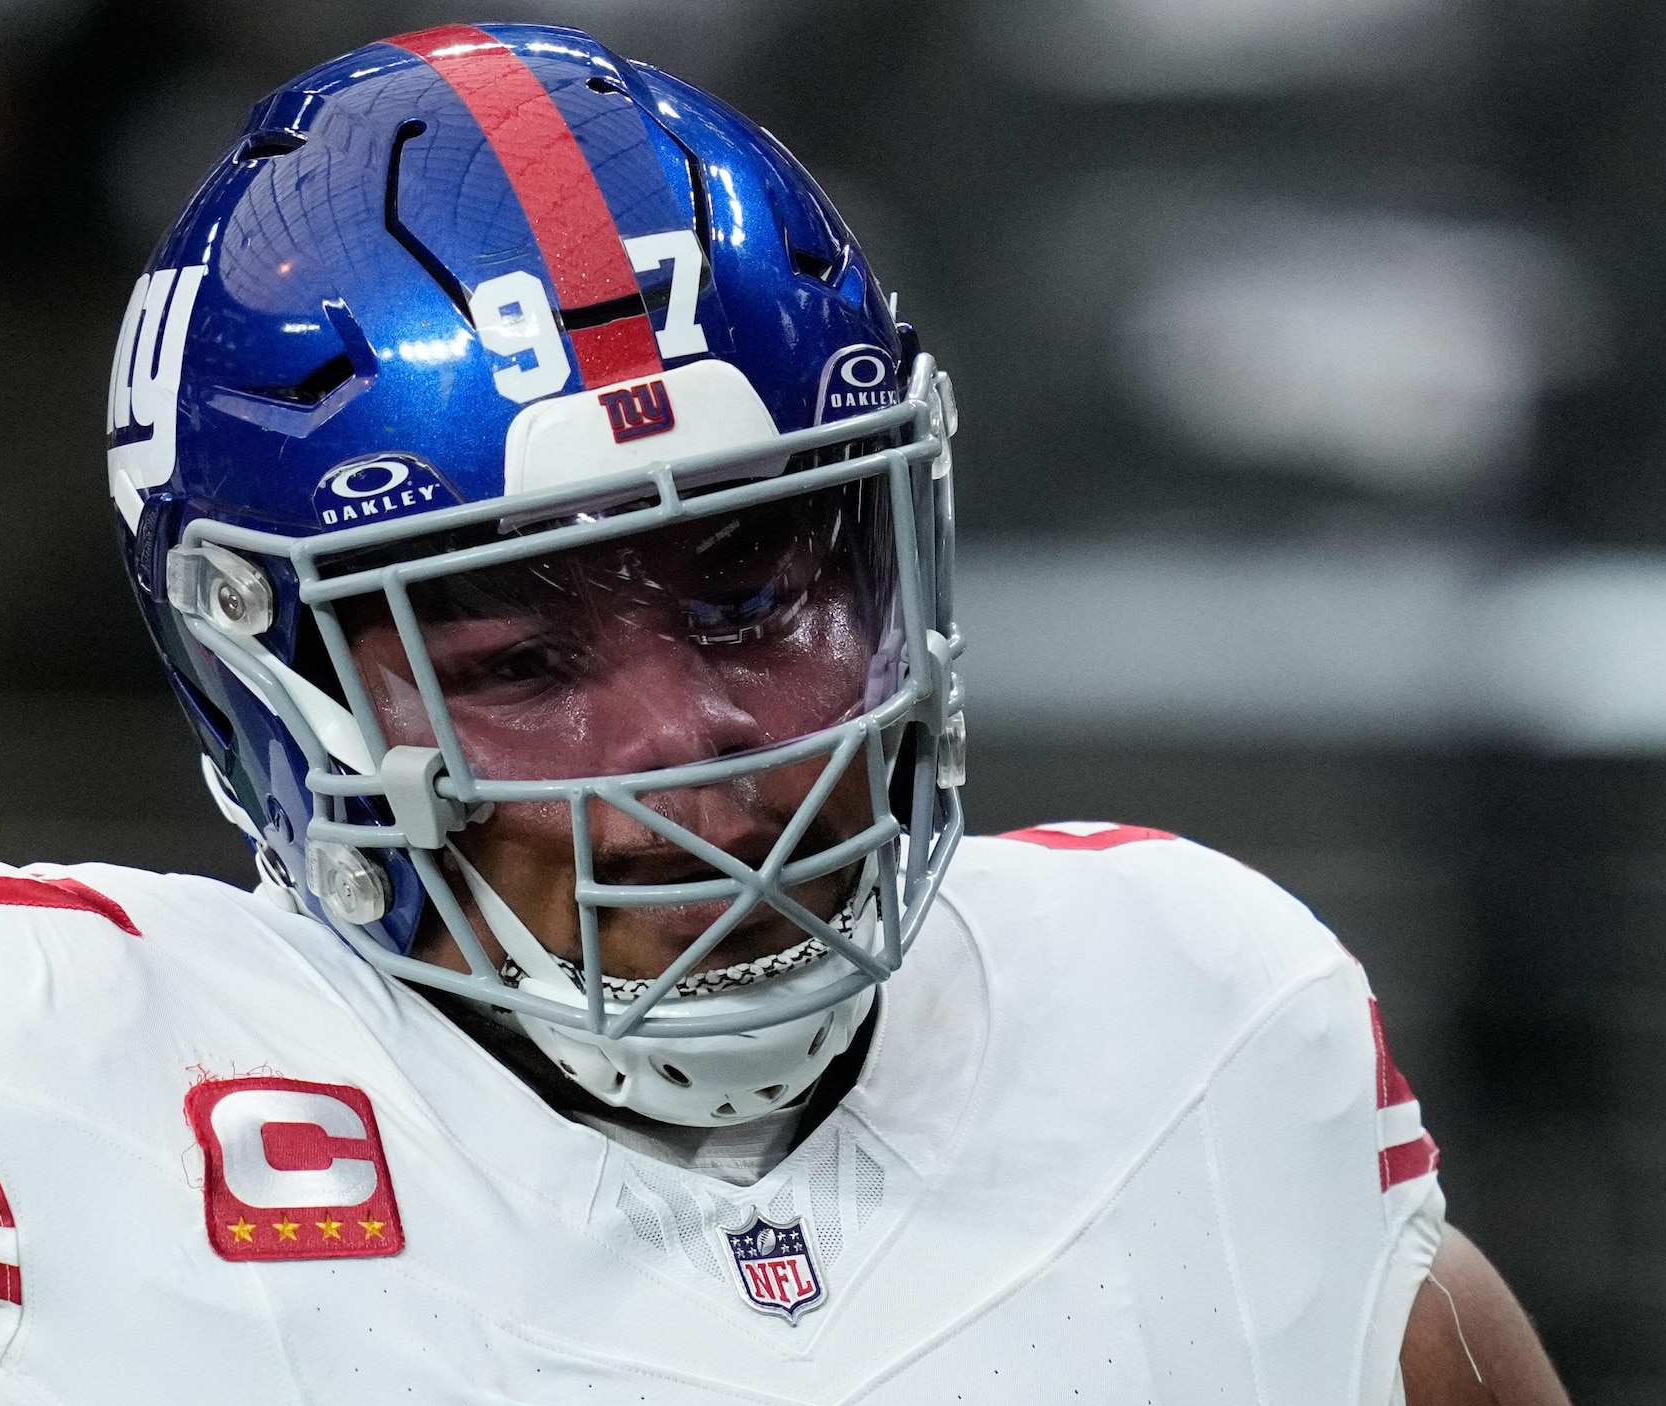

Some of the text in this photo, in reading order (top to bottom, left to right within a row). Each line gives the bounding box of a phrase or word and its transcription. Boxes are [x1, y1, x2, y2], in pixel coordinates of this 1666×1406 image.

[831, 390, 896, 409] OAKLEY
[322, 484, 438, 525] OAKLEY
[211, 1090, 378, 1210] C
[745, 1258, 814, 1303] NFL
